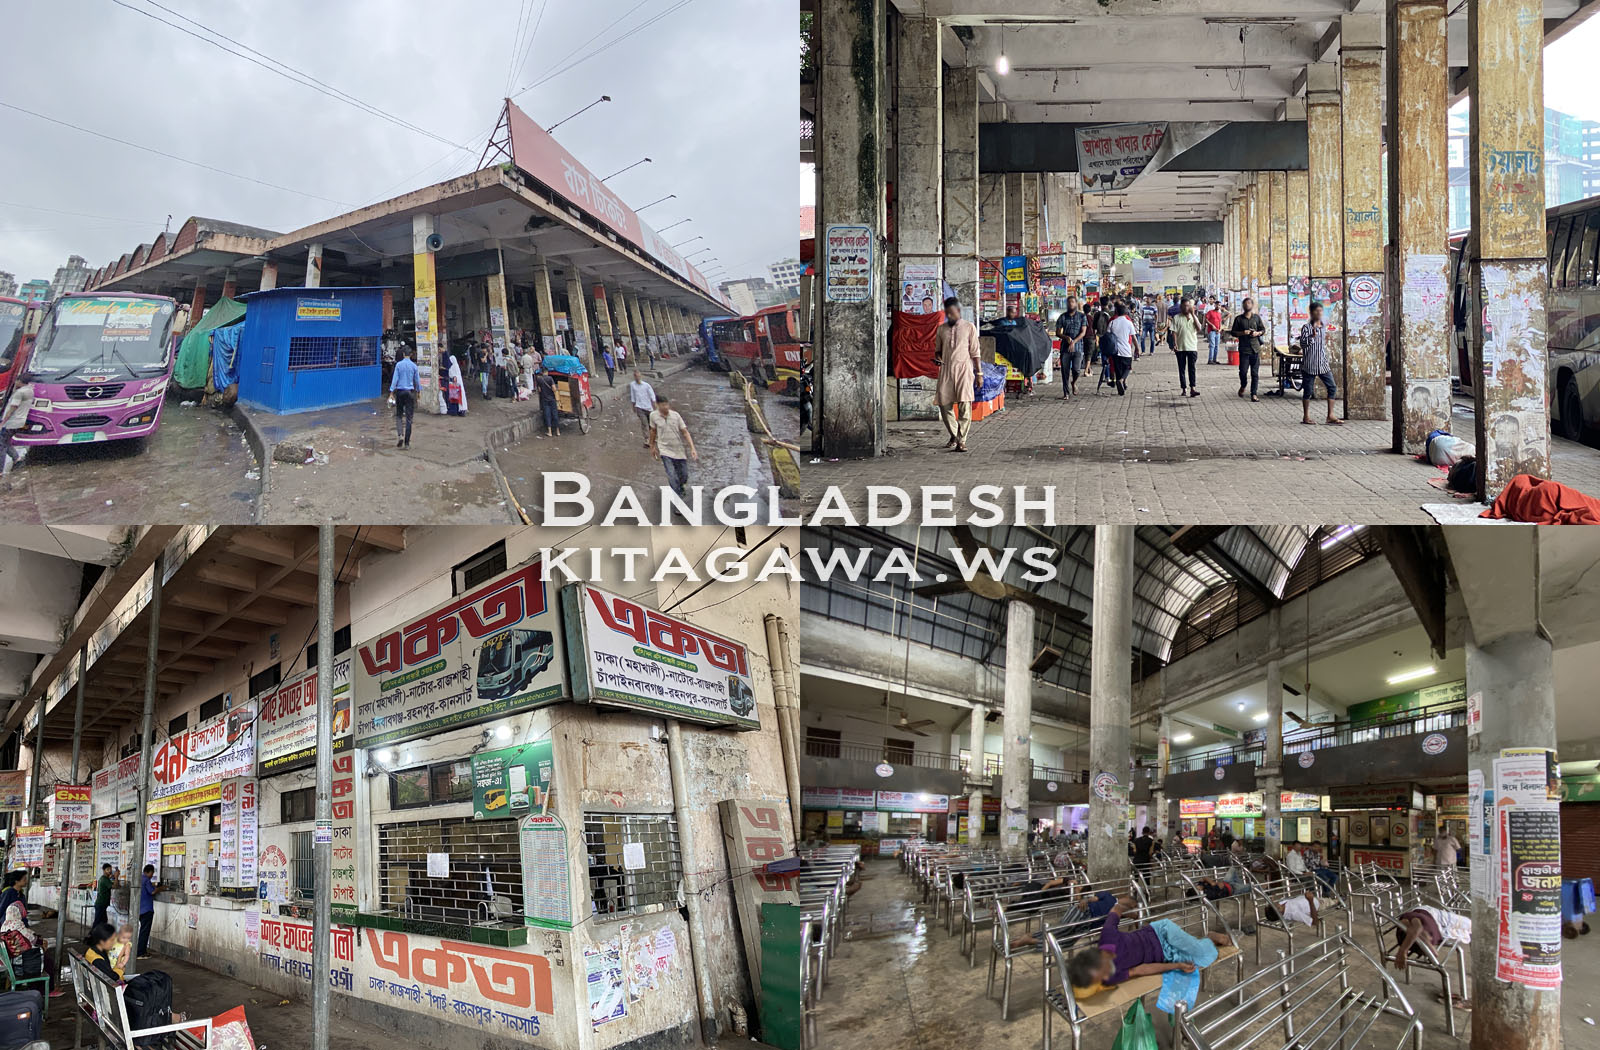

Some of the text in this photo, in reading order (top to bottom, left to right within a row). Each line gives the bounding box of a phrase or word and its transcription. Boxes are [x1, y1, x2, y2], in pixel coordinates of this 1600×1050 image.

[1142, 127, 1164, 151] হোটে
[358, 561, 549, 676] একতা
[587, 588, 749, 678] একতা
[304, 672, 318, 708] আ
[153, 733, 190, 785] এনা
[331, 755, 353, 819] একতা
[333, 826, 352, 839] ঢাকা
[333, 846, 352, 860] নাটোর
[332, 864, 355, 881] রাজশাহী
[1521, 875, 1561, 889] জনস
[333, 884, 354, 902] চাঁপাই
[366, 927, 554, 1015] একতা
